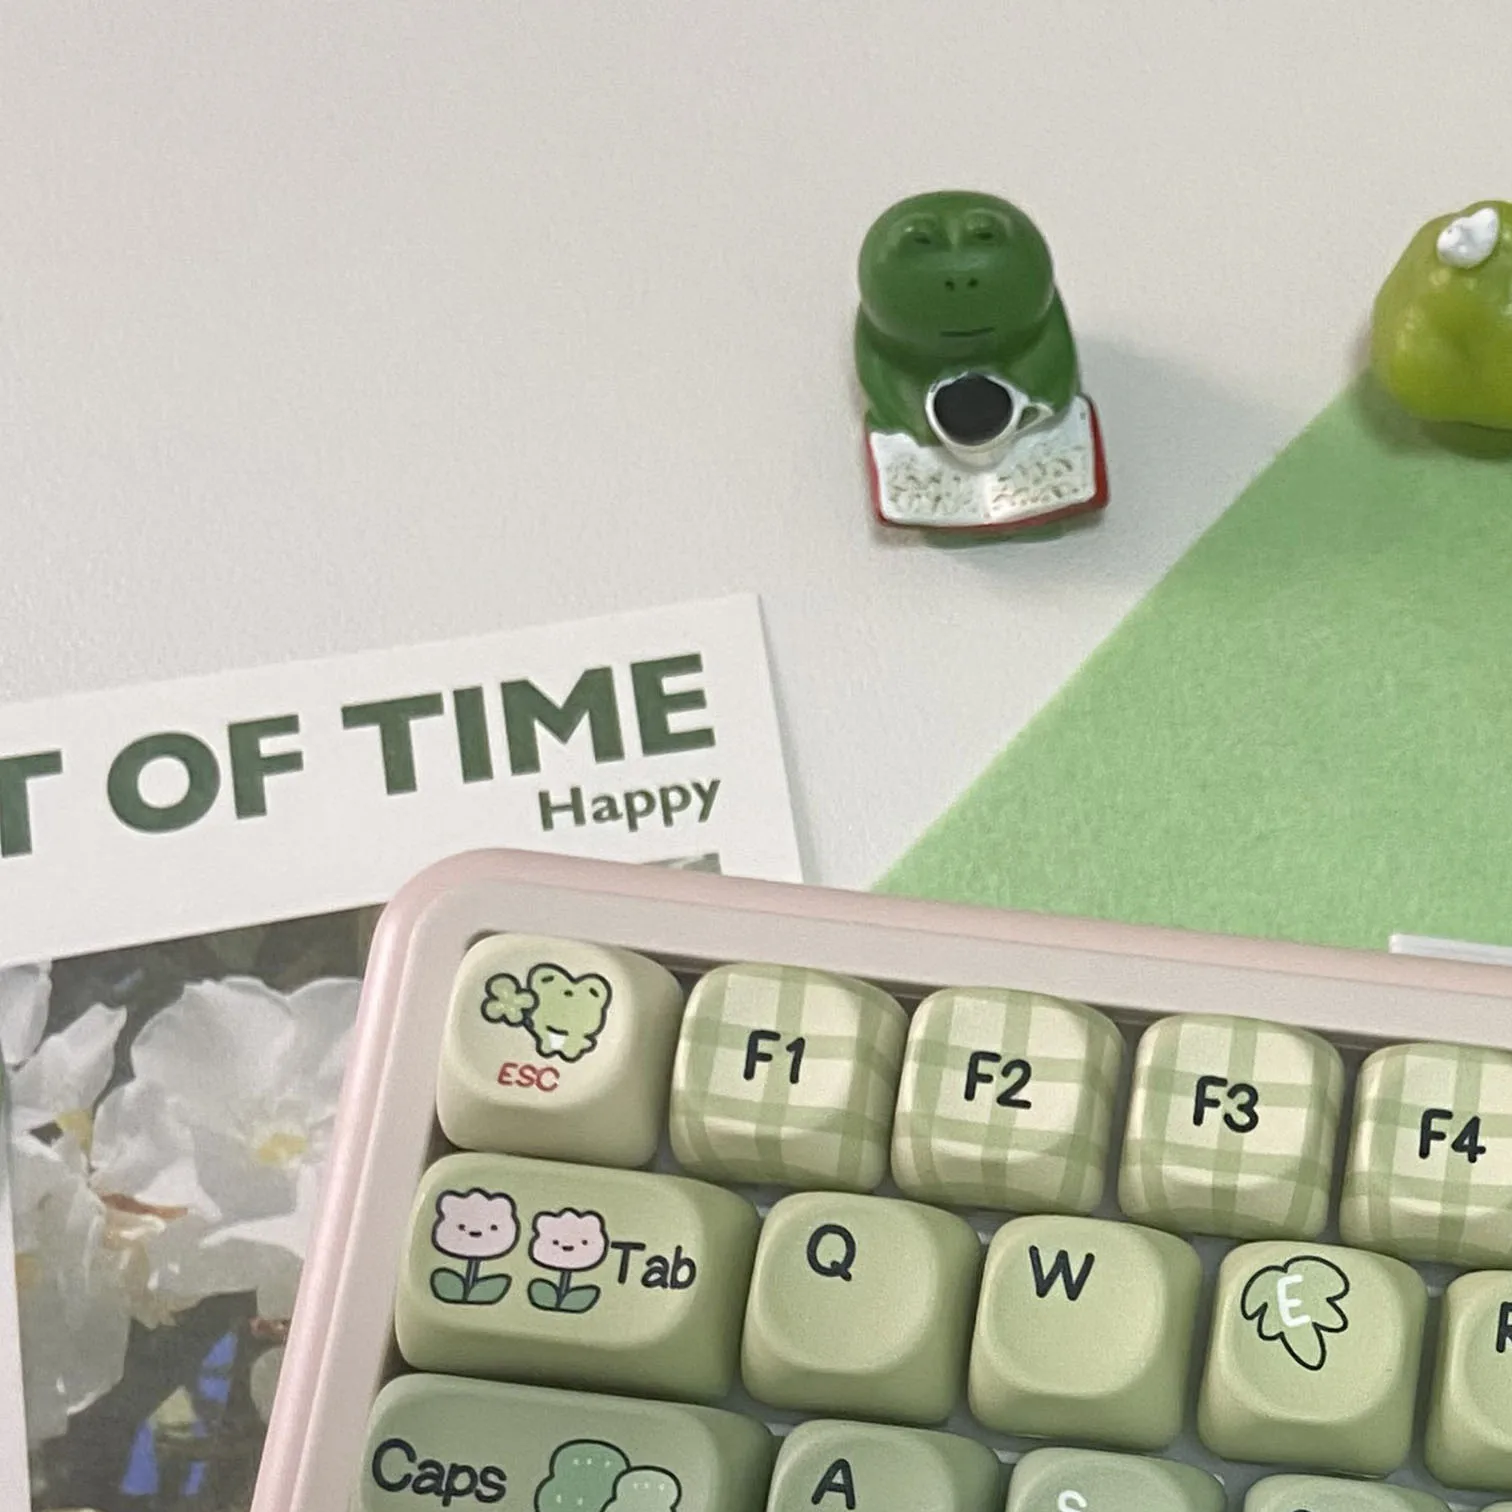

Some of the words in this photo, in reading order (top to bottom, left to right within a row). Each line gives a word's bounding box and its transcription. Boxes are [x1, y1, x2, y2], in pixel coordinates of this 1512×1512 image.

[106, 713, 305, 834] OF
[340, 652, 717, 797] TIME
[538, 777, 721, 833] Happy
[497, 1062, 559, 1093] ESC
[743, 1029, 805, 1084] F1
[963, 1051, 1032, 1108] F2
[1192, 1075, 1259, 1133] F3
[1418, 1108, 1486, 1164] F4
[609, 1241, 697, 1291] Tab
[806, 1223, 856, 1281] Q
[1029, 1244, 1095, 1301] W
[1277, 1274, 1311, 1328] E
[371, 1438, 507, 1508] Caps
[811, 1458, 856, 1511] A
